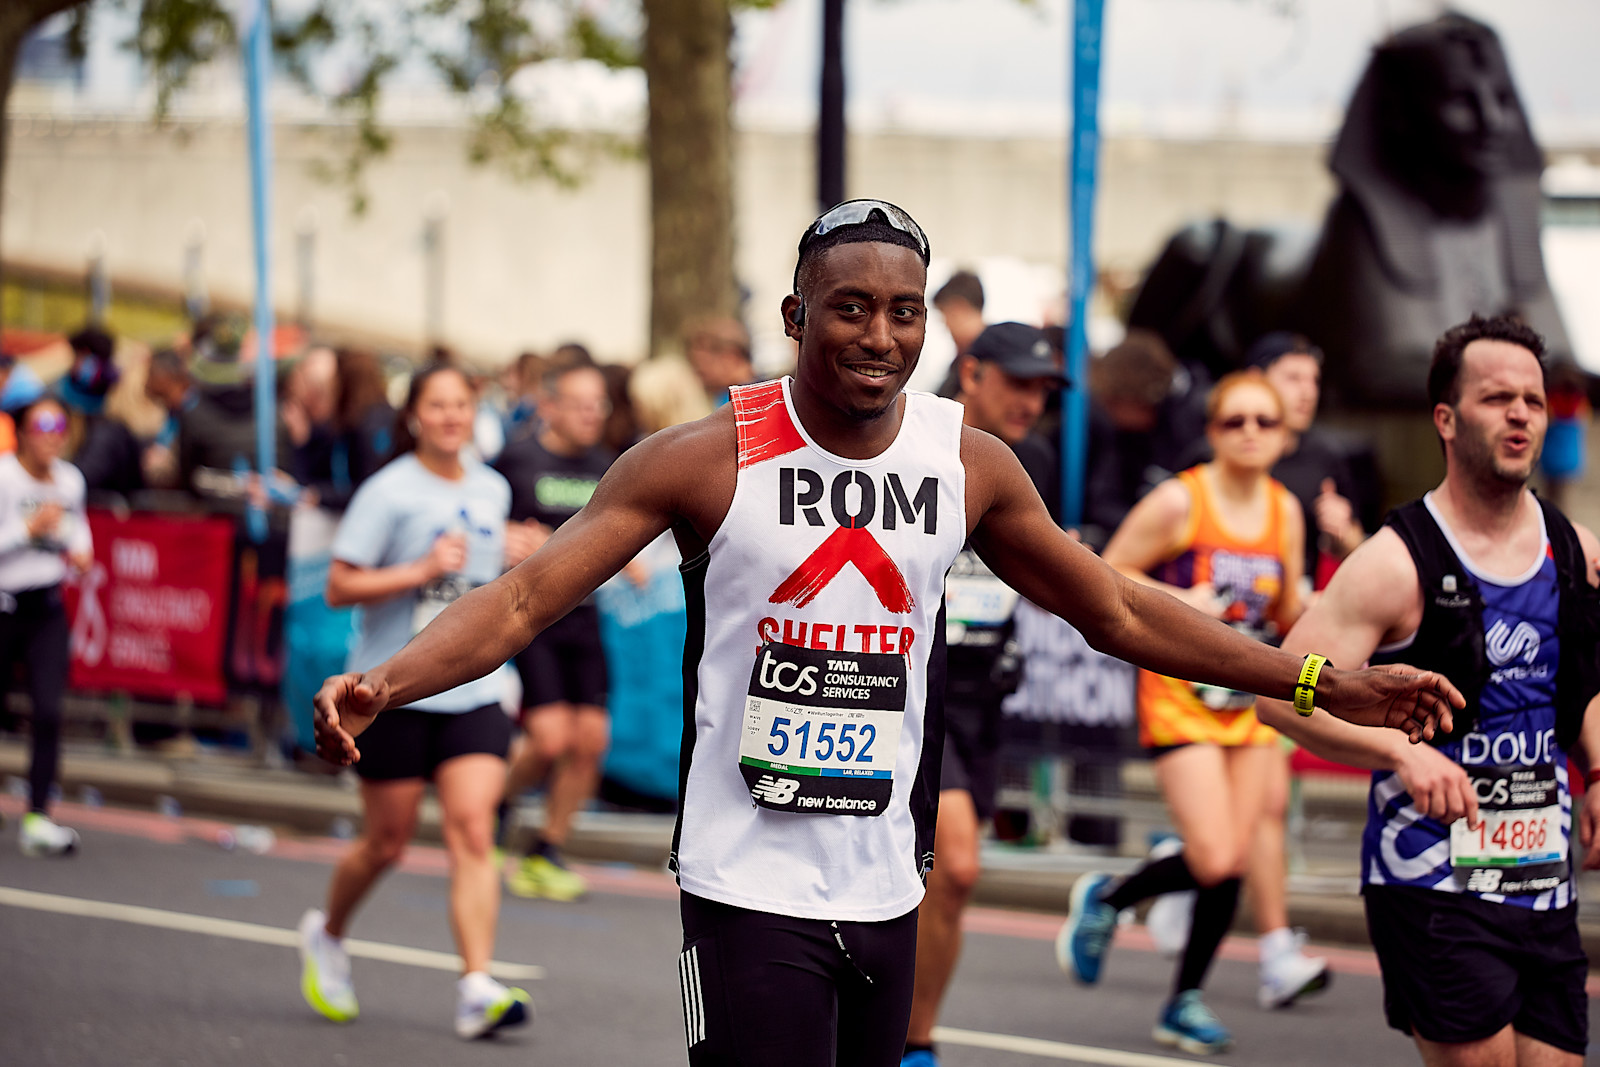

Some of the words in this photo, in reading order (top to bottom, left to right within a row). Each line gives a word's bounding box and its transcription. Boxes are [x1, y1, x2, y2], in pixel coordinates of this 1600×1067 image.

[779, 467, 938, 535] ROM
[756, 617, 915, 669] SHELTER
[759, 650, 819, 696] tcs
[827, 660, 859, 673] TATA
[824, 673, 899, 688] CONSULTANCY
[822, 687, 871, 700] SERVICES
[768, 716, 877, 763] 51552
[770, 763, 789, 771] MEDAL
[797, 796, 825, 808] new
[826, 795, 877, 810] balance
[1476, 818, 1548, 851] 14866
